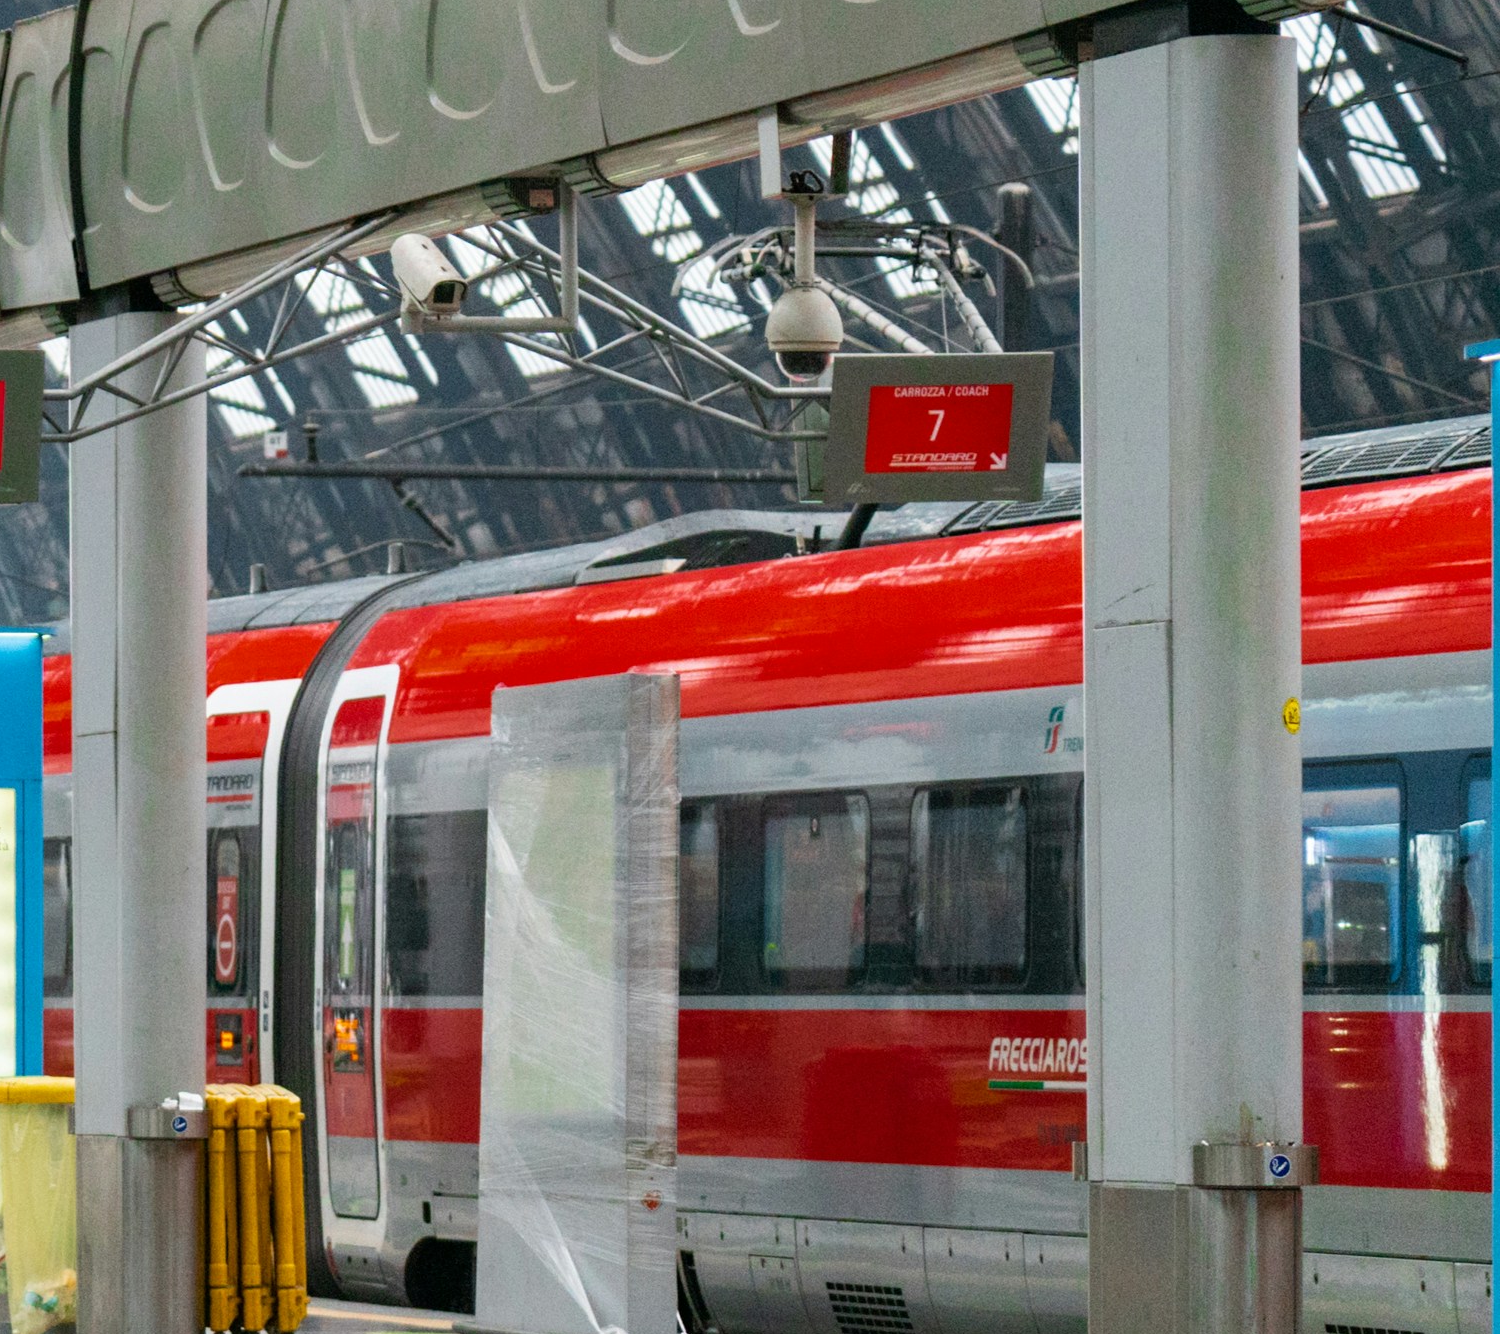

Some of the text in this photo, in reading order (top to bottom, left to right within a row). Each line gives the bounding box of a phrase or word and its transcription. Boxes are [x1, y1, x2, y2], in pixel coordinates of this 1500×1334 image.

[894, 386, 946, 398] CARROZZA
[955, 385, 990, 397] COACH
[927, 409, 946, 442] 7
[891, 452, 978, 462] STANDARD
